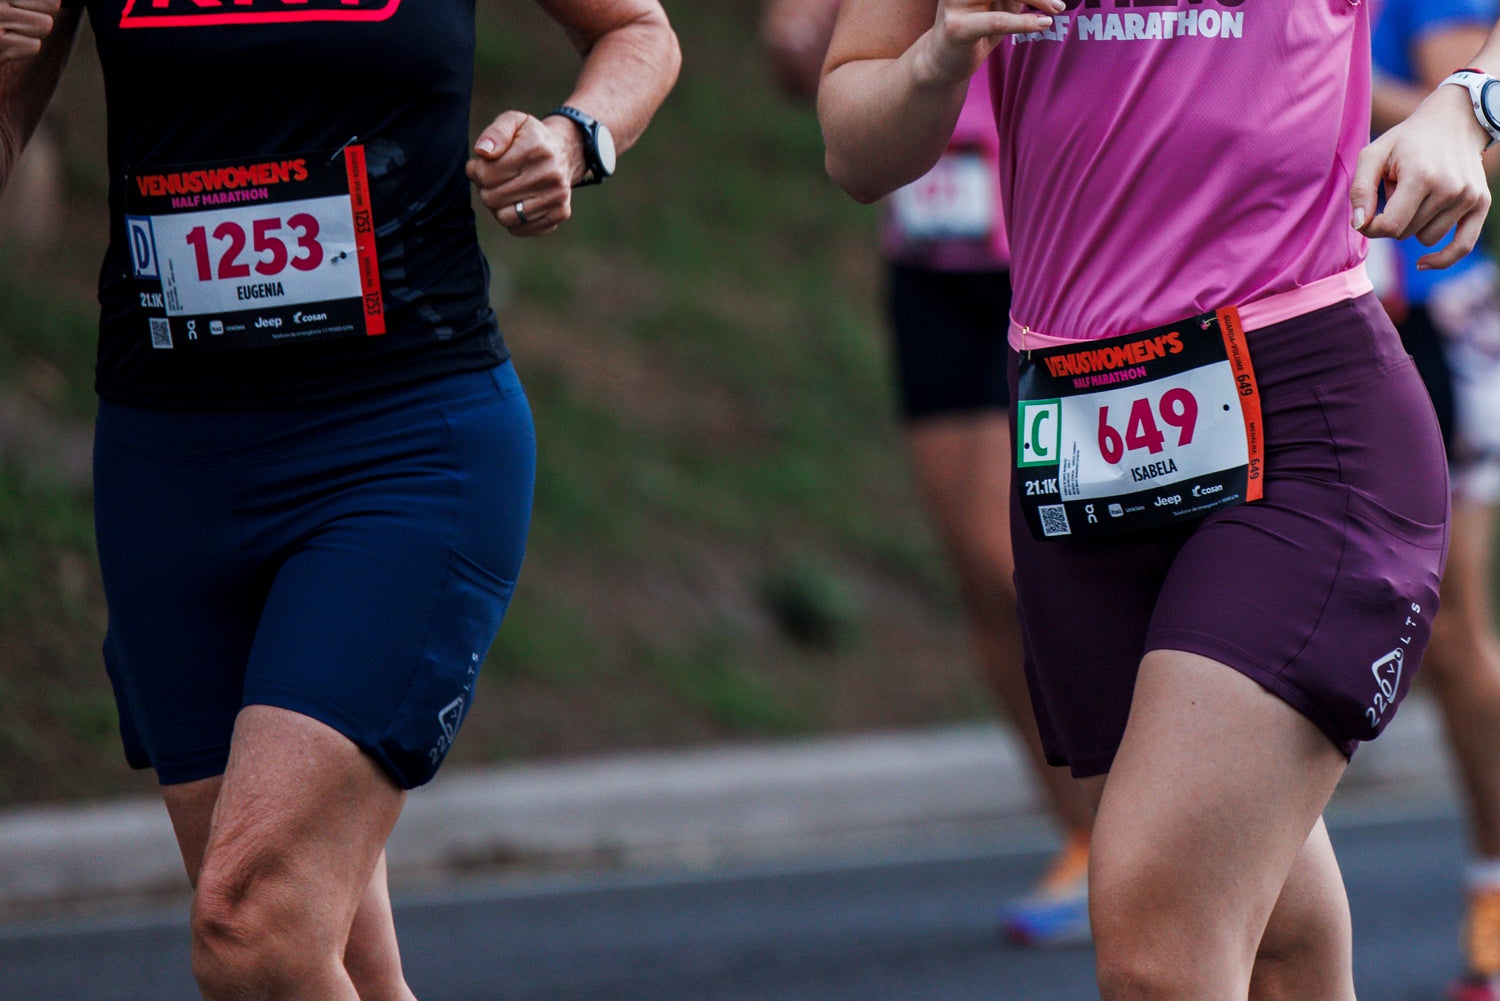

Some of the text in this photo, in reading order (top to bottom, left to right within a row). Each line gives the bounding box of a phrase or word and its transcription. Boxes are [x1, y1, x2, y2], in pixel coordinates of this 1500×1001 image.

[1011, 9, 1245, 46] LF MARATHON
[136, 158, 308, 197] VENUSWOMEN'S
[171, 187, 268, 209] HALF MARATHON
[355, 210, 371, 234] 1253
[132, 224, 150, 270] D
[185, 212, 323, 282] 1253
[140, 292, 164, 308] 21.1K
[237, 281, 285, 301] EUGENIA
[366, 291, 381, 316] 1253
[254, 317, 282, 328] Jeep
[1044, 331, 1184, 379] VENUSWOMEN'S
[1223, 314, 1254, 397] GUARDA-VOLUME 649
[1072, 365, 1147, 389] HALF MARATHON
[1031, 409, 1049, 457] C
[1097, 387, 1199, 465] 649
[1130, 458, 1178, 483] ISABELA
[1249, 458, 1260, 480] 649
[1025, 478, 1060, 496] 21.1K
[1153, 494, 1182, 507] Jeep
